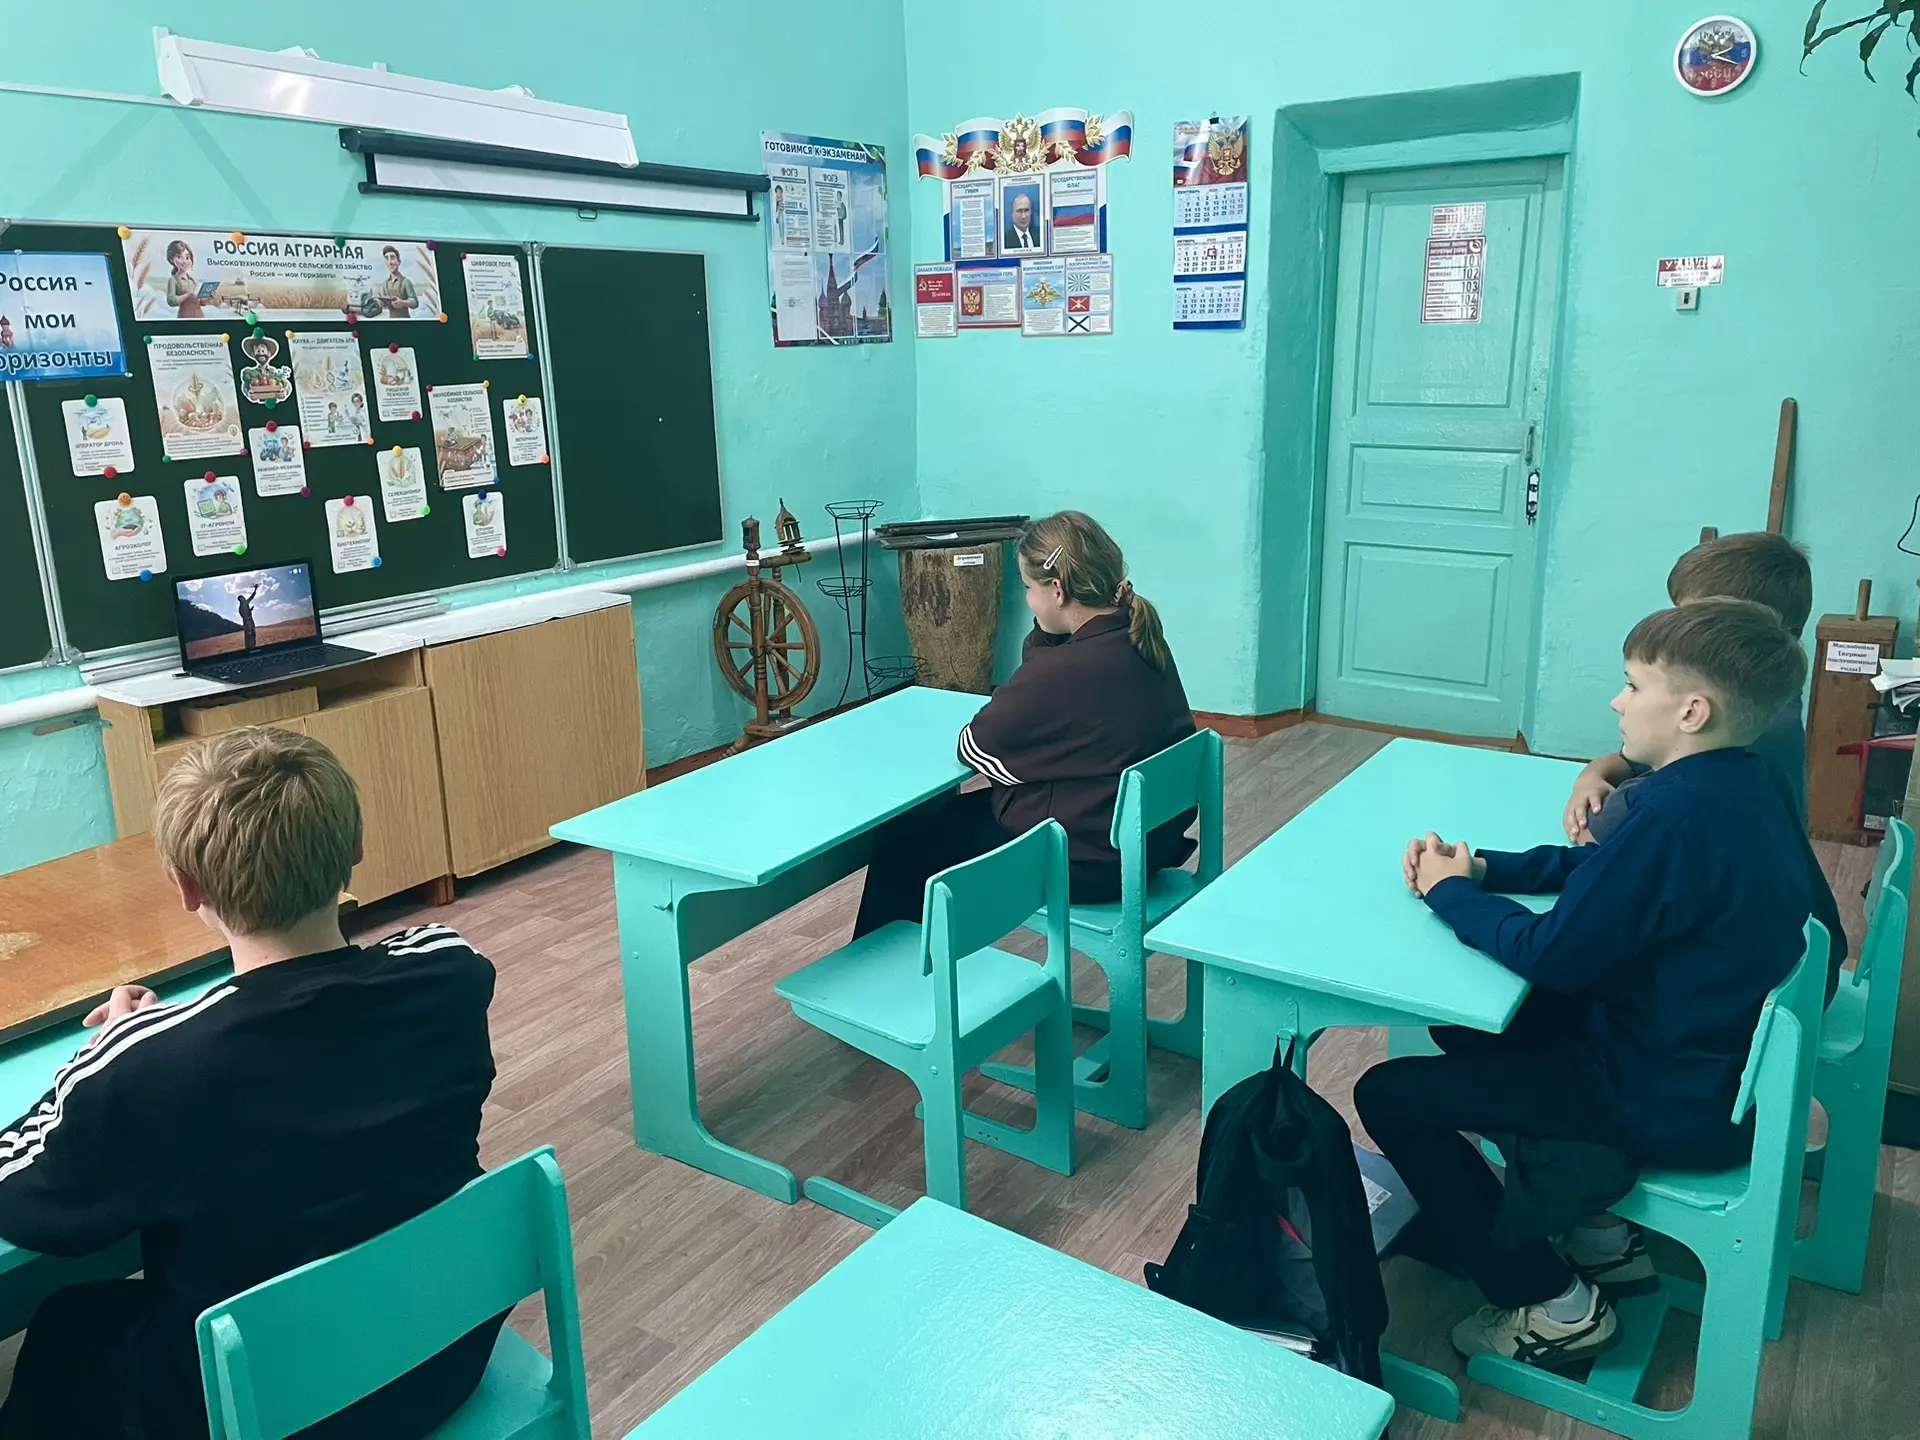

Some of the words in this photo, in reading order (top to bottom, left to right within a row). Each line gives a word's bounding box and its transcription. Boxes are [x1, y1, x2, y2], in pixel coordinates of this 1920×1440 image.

[765, 141, 812, 155] ГОТОВИМСЯ
[815, 147, 820, 156] К
[822, 148, 866, 161] ЭКЗАМЕНАМ
[213, 240, 279, 257] РОССИЯ
[284, 243, 364, 260] АГРАРНАЯ
[207, 258, 297, 268] Высокотехнологичное
[298, 261, 334, 270] сельское
[335, 262, 373, 271] хозяйство
[1464, 255, 1480, 267] 101
[300, 271, 336, 279] горизонты
[1463, 268, 1479, 279] 102
[1462, 281, 1478, 292] 103
[1461, 294, 1477, 305] 104
[1460, 307, 1477, 318] 112
[24, 313, 76, 329] мои
[114, 541, 152, 551] АГРОЭКОЛОГ
